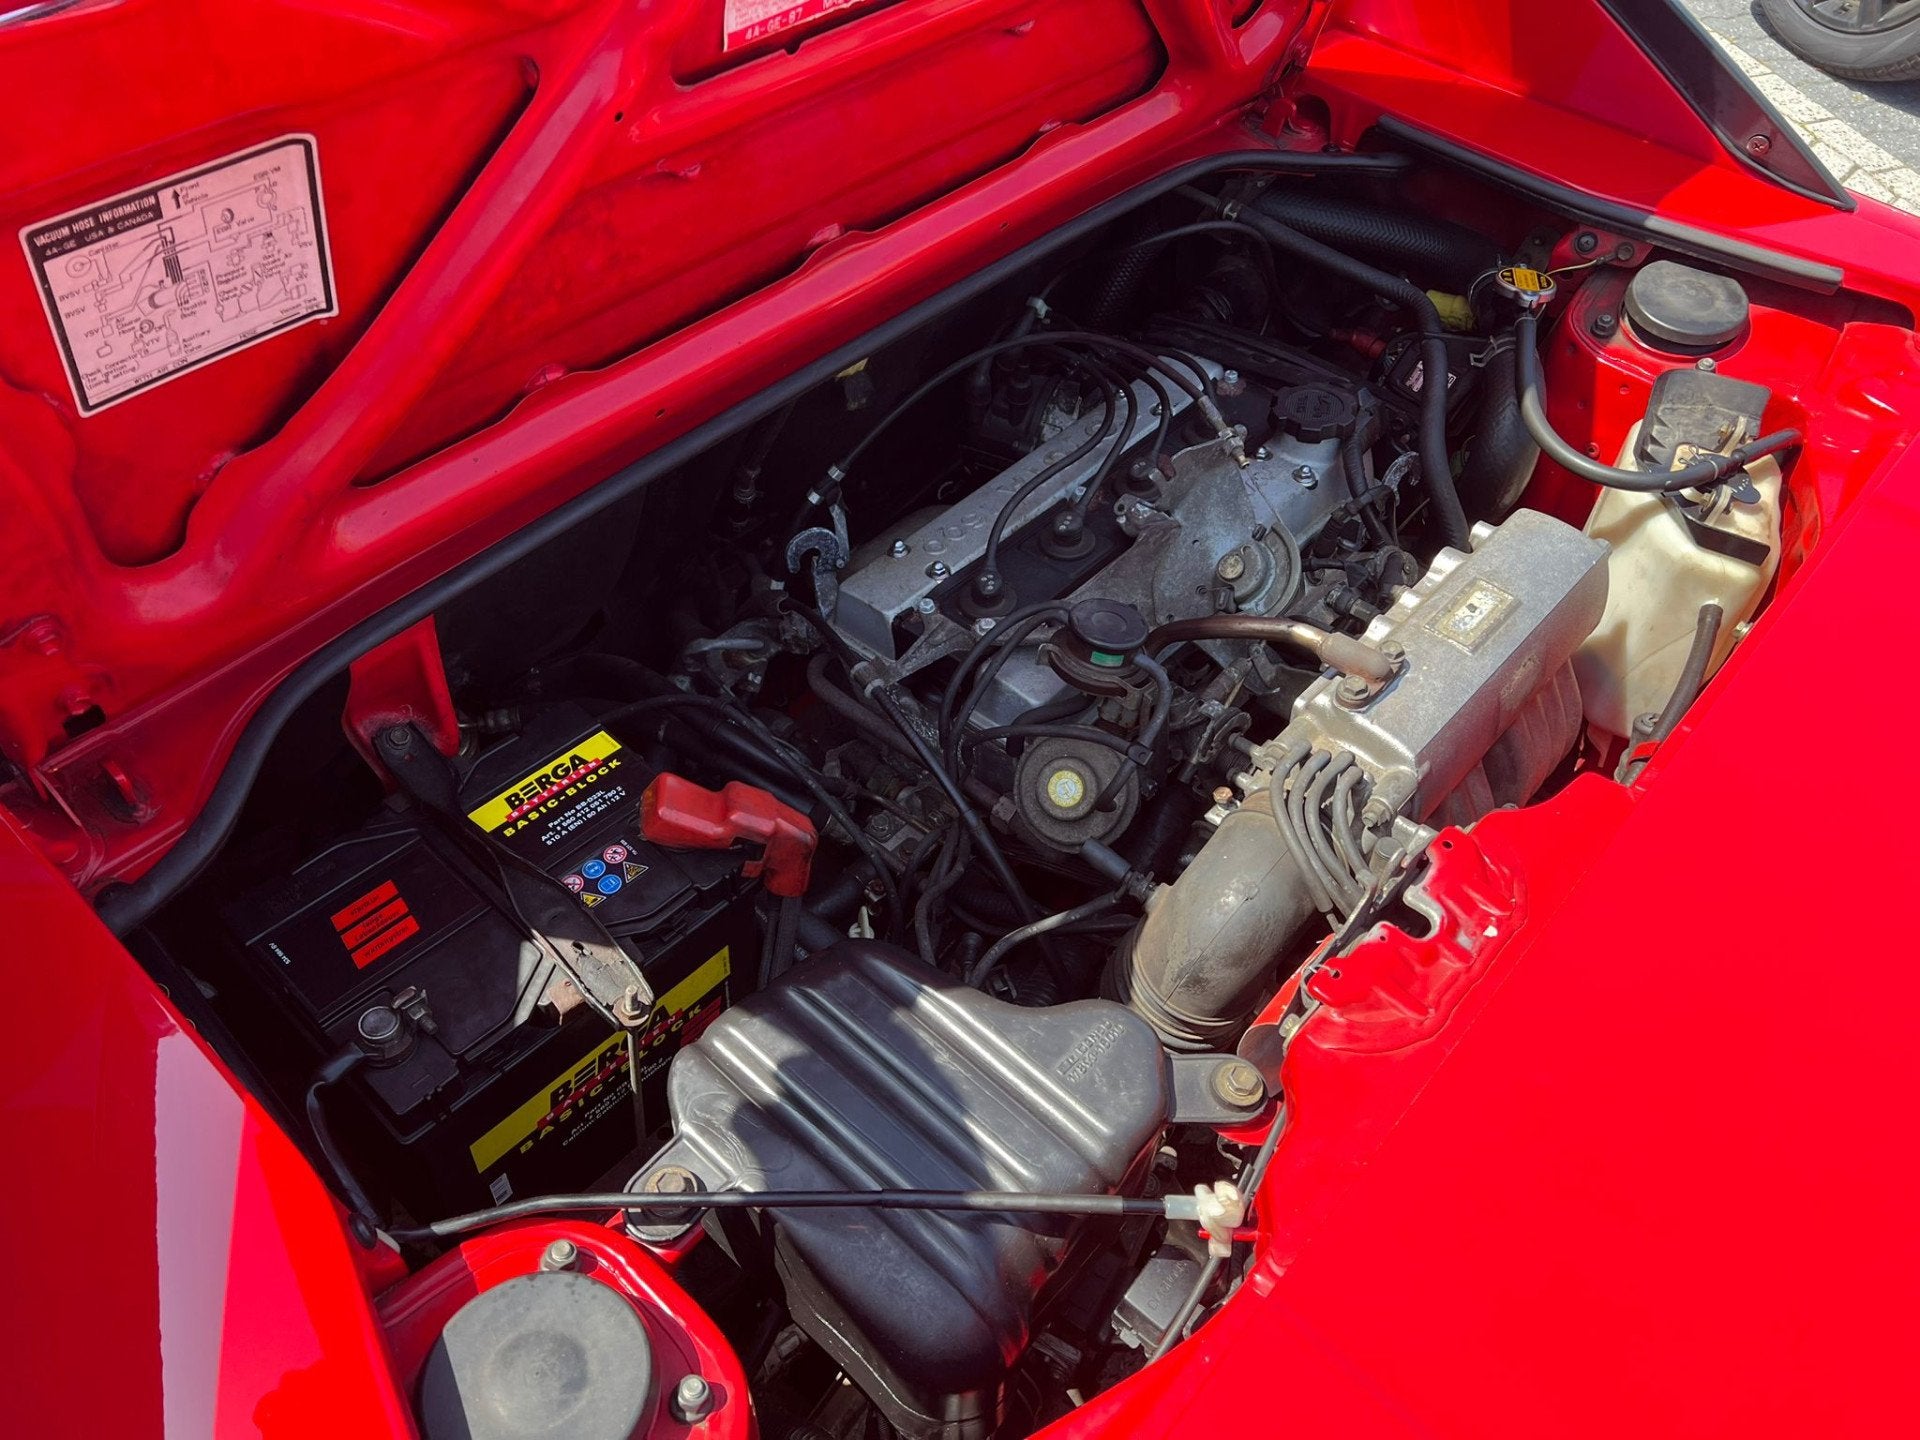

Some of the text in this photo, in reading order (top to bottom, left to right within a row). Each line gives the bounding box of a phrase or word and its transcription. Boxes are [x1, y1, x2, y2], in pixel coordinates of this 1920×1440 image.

[34, 194, 157, 247] VACUUM HOSE INFORMATION
[84, 230, 104, 242] USA
[116, 211, 154, 231] CANADA
[503, 754, 589, 810] BERGA
[503, 758, 622, 837] BASIC-BLOCK
[511, 761, 598, 818] BATTERIEN
[597, 803, 608, 812] Ah
[548, 816, 565, 828] Part
[564, 809, 576, 818] No
